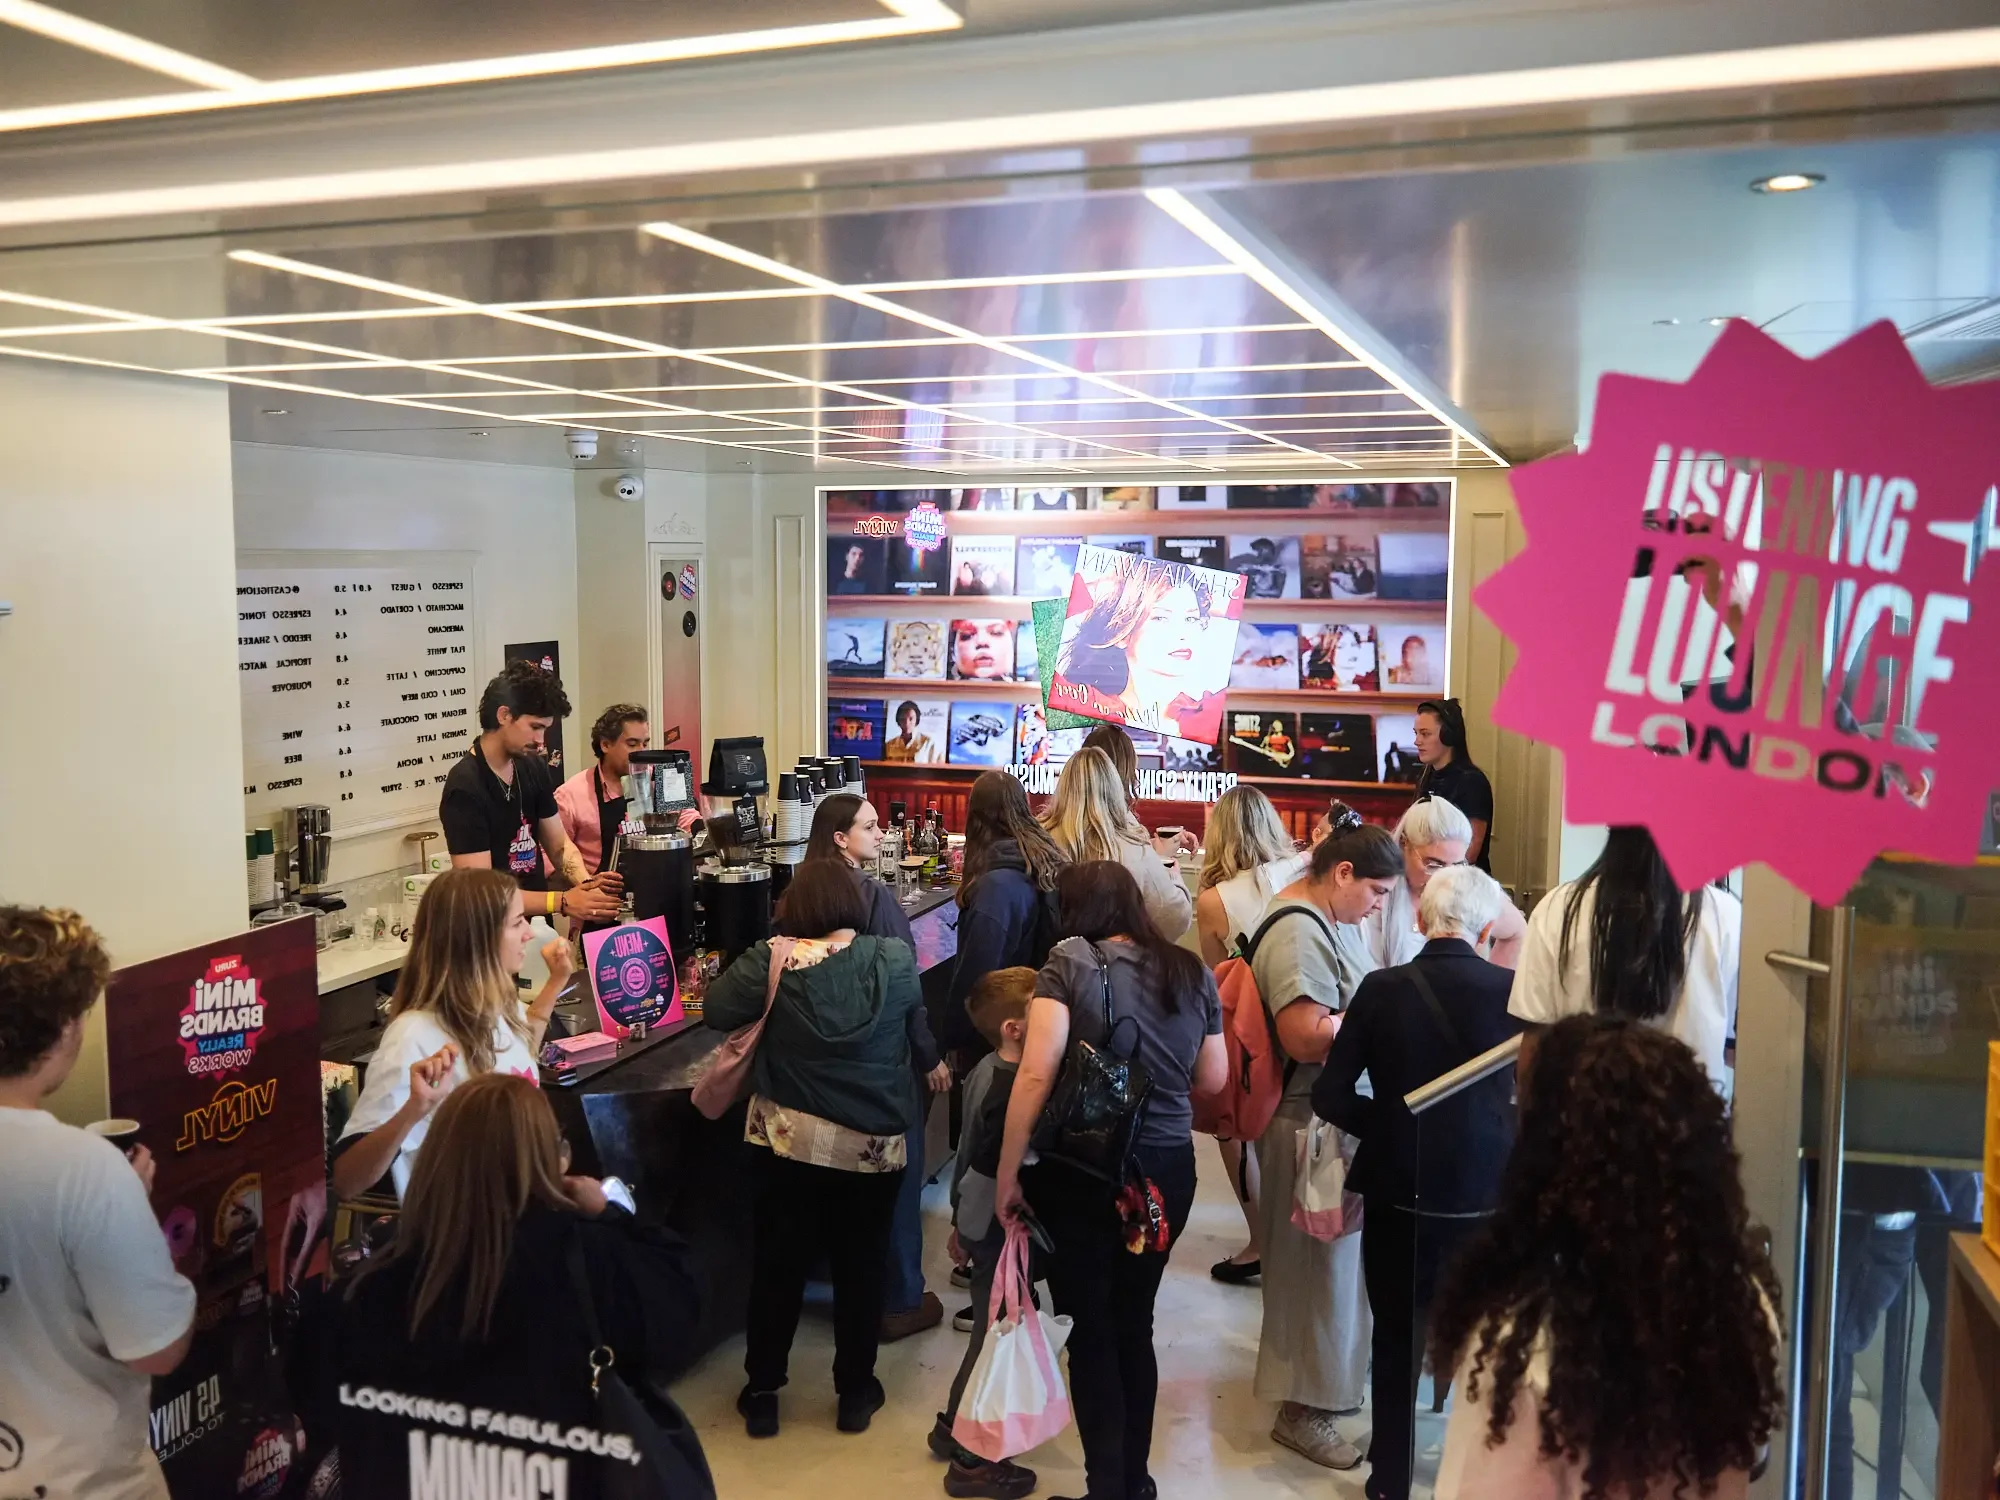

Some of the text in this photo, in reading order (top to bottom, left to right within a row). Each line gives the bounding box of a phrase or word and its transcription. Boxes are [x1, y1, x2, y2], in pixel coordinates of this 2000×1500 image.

[1643, 444, 1917, 571] LISTENING
[1605, 547, 1970, 747] LOUNGE
[1591, 701, 1937, 809] LONDON
[338, 1383, 643, 1466] LOOKING FABULOUS,
